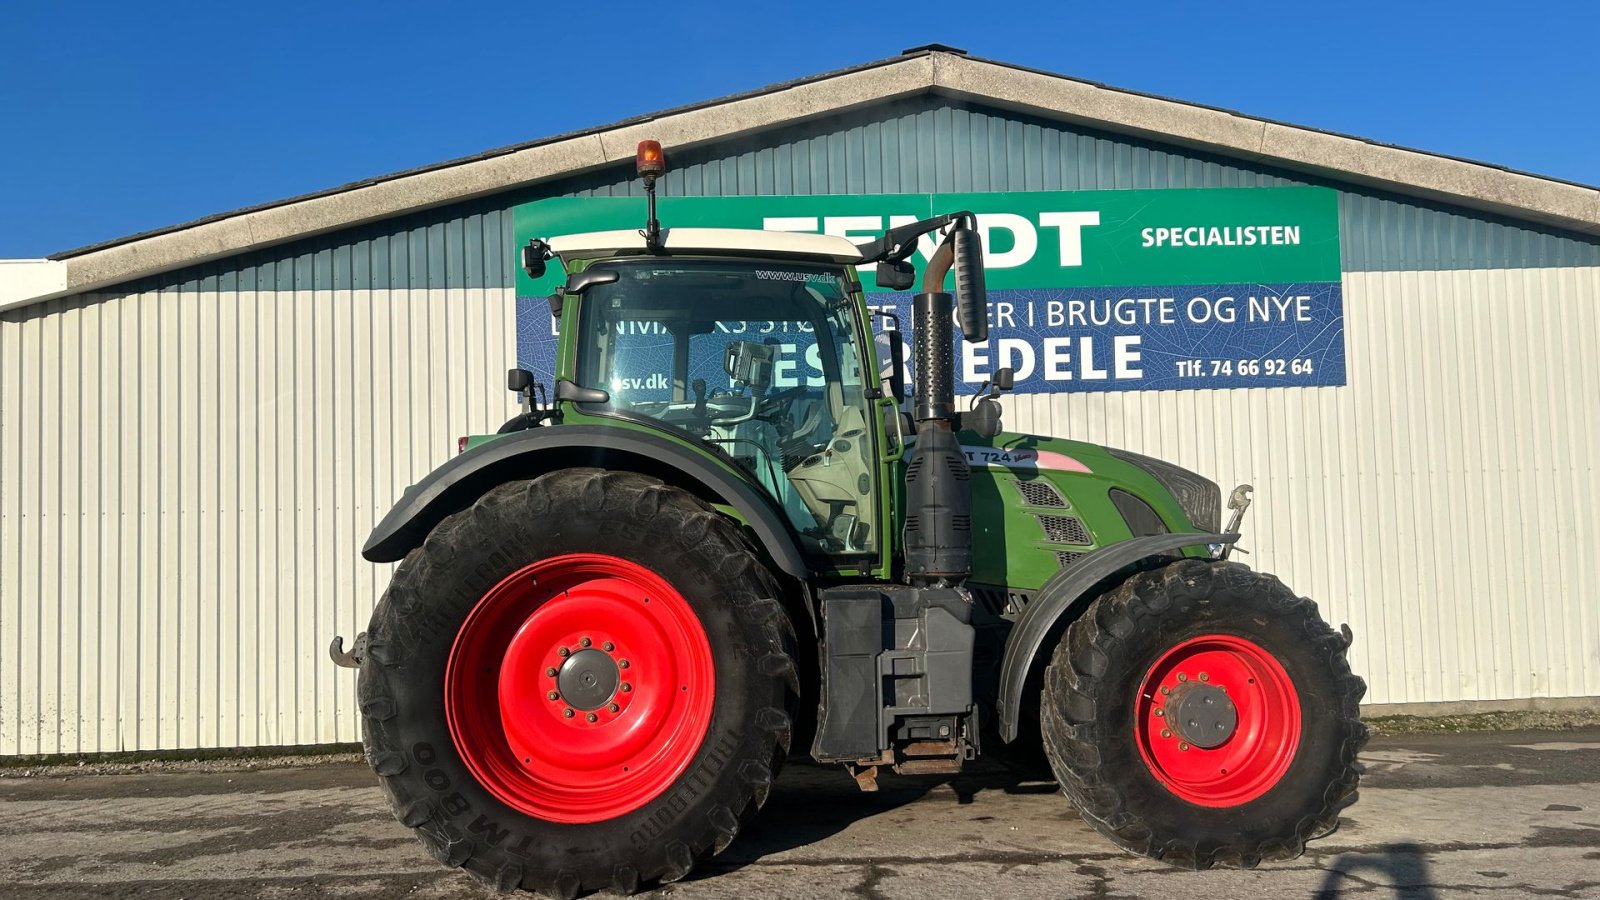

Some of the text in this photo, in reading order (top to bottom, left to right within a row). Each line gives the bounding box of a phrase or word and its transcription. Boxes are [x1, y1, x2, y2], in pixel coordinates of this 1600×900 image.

[1141, 225, 1300, 247] SPECIALISTEN
[756, 270, 835, 284] www.usv.dk
[1048, 299, 1175, 327] BRUGTE
[1187, 297, 1235, 323] OG
[1249, 296, 1312, 321] NYE
[1176, 358, 1313, 377] Tlf. 74 66 92 64
[613, 374, 668, 390] sv.dk
[981, 452, 1011, 462] 724
[629, 727, 745, 853] TRELLEBORG
